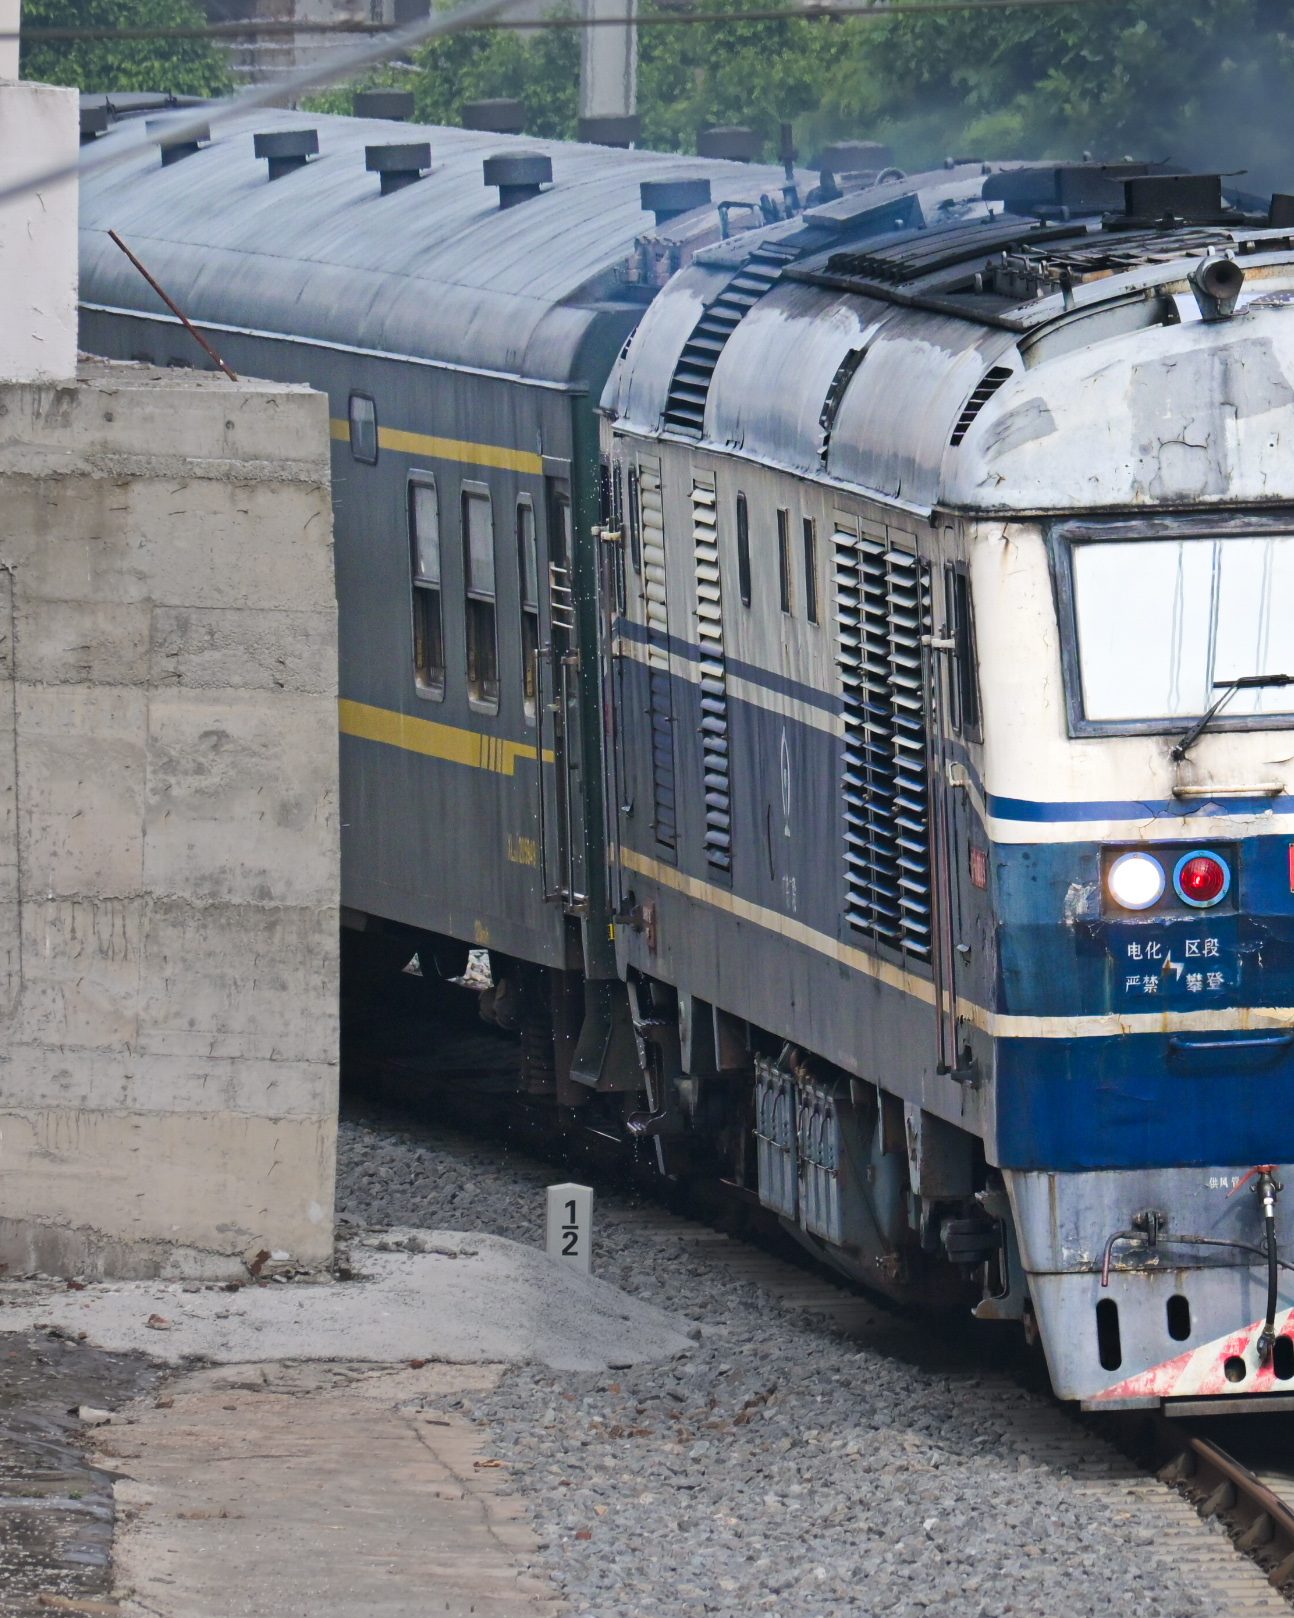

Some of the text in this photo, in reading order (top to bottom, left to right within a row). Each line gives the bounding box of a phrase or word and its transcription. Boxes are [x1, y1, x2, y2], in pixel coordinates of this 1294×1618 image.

[1127, 938, 1220, 960] 电化 区段
[1125, 971, 1225, 993] 严禁 攀登
[564, 1200, 576, 1224] 1
[562, 1231, 579, 1256] 2
